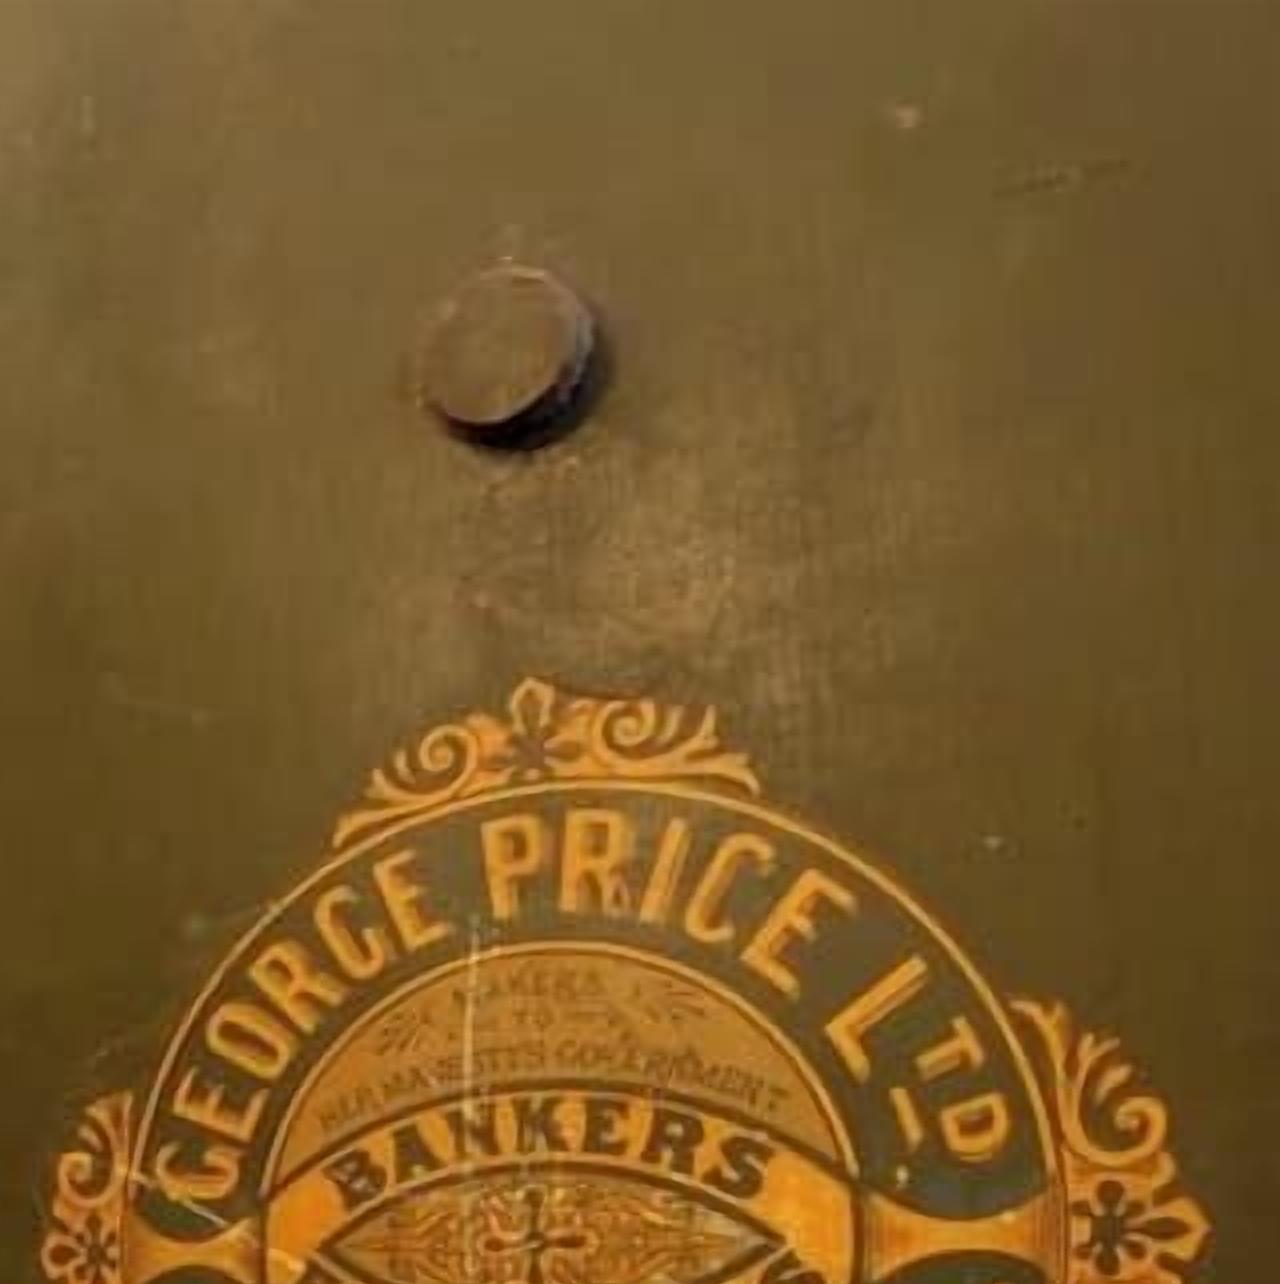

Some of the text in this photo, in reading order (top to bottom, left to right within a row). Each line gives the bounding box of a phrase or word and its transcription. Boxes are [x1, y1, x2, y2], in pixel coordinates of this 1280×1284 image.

[155, 847, 453, 1201] GEORGE
[480, 807, 859, 1001] PRICE
[324, 1094, 777, 1206] BANKERS
